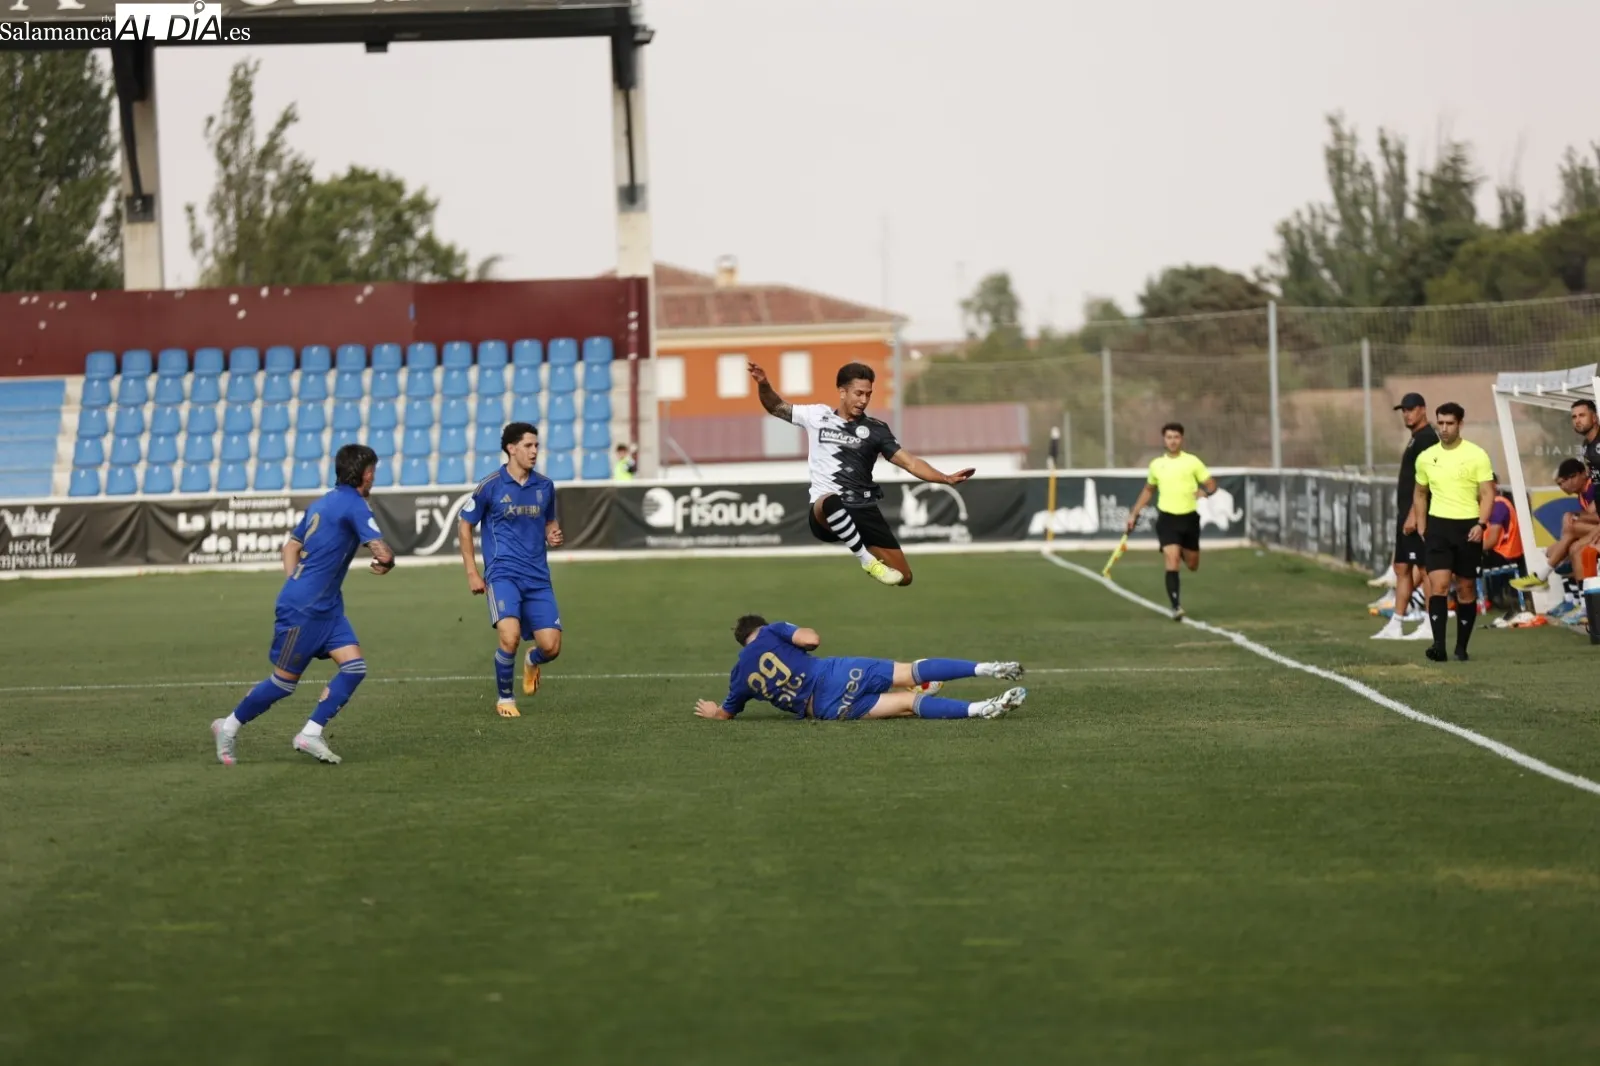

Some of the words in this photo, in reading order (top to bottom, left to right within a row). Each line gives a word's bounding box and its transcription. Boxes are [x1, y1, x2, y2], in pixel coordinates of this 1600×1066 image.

[821, 430, 861, 444] telefurgo
[675, 488, 785, 533] fisaude
[747, 651, 792, 699] 29
